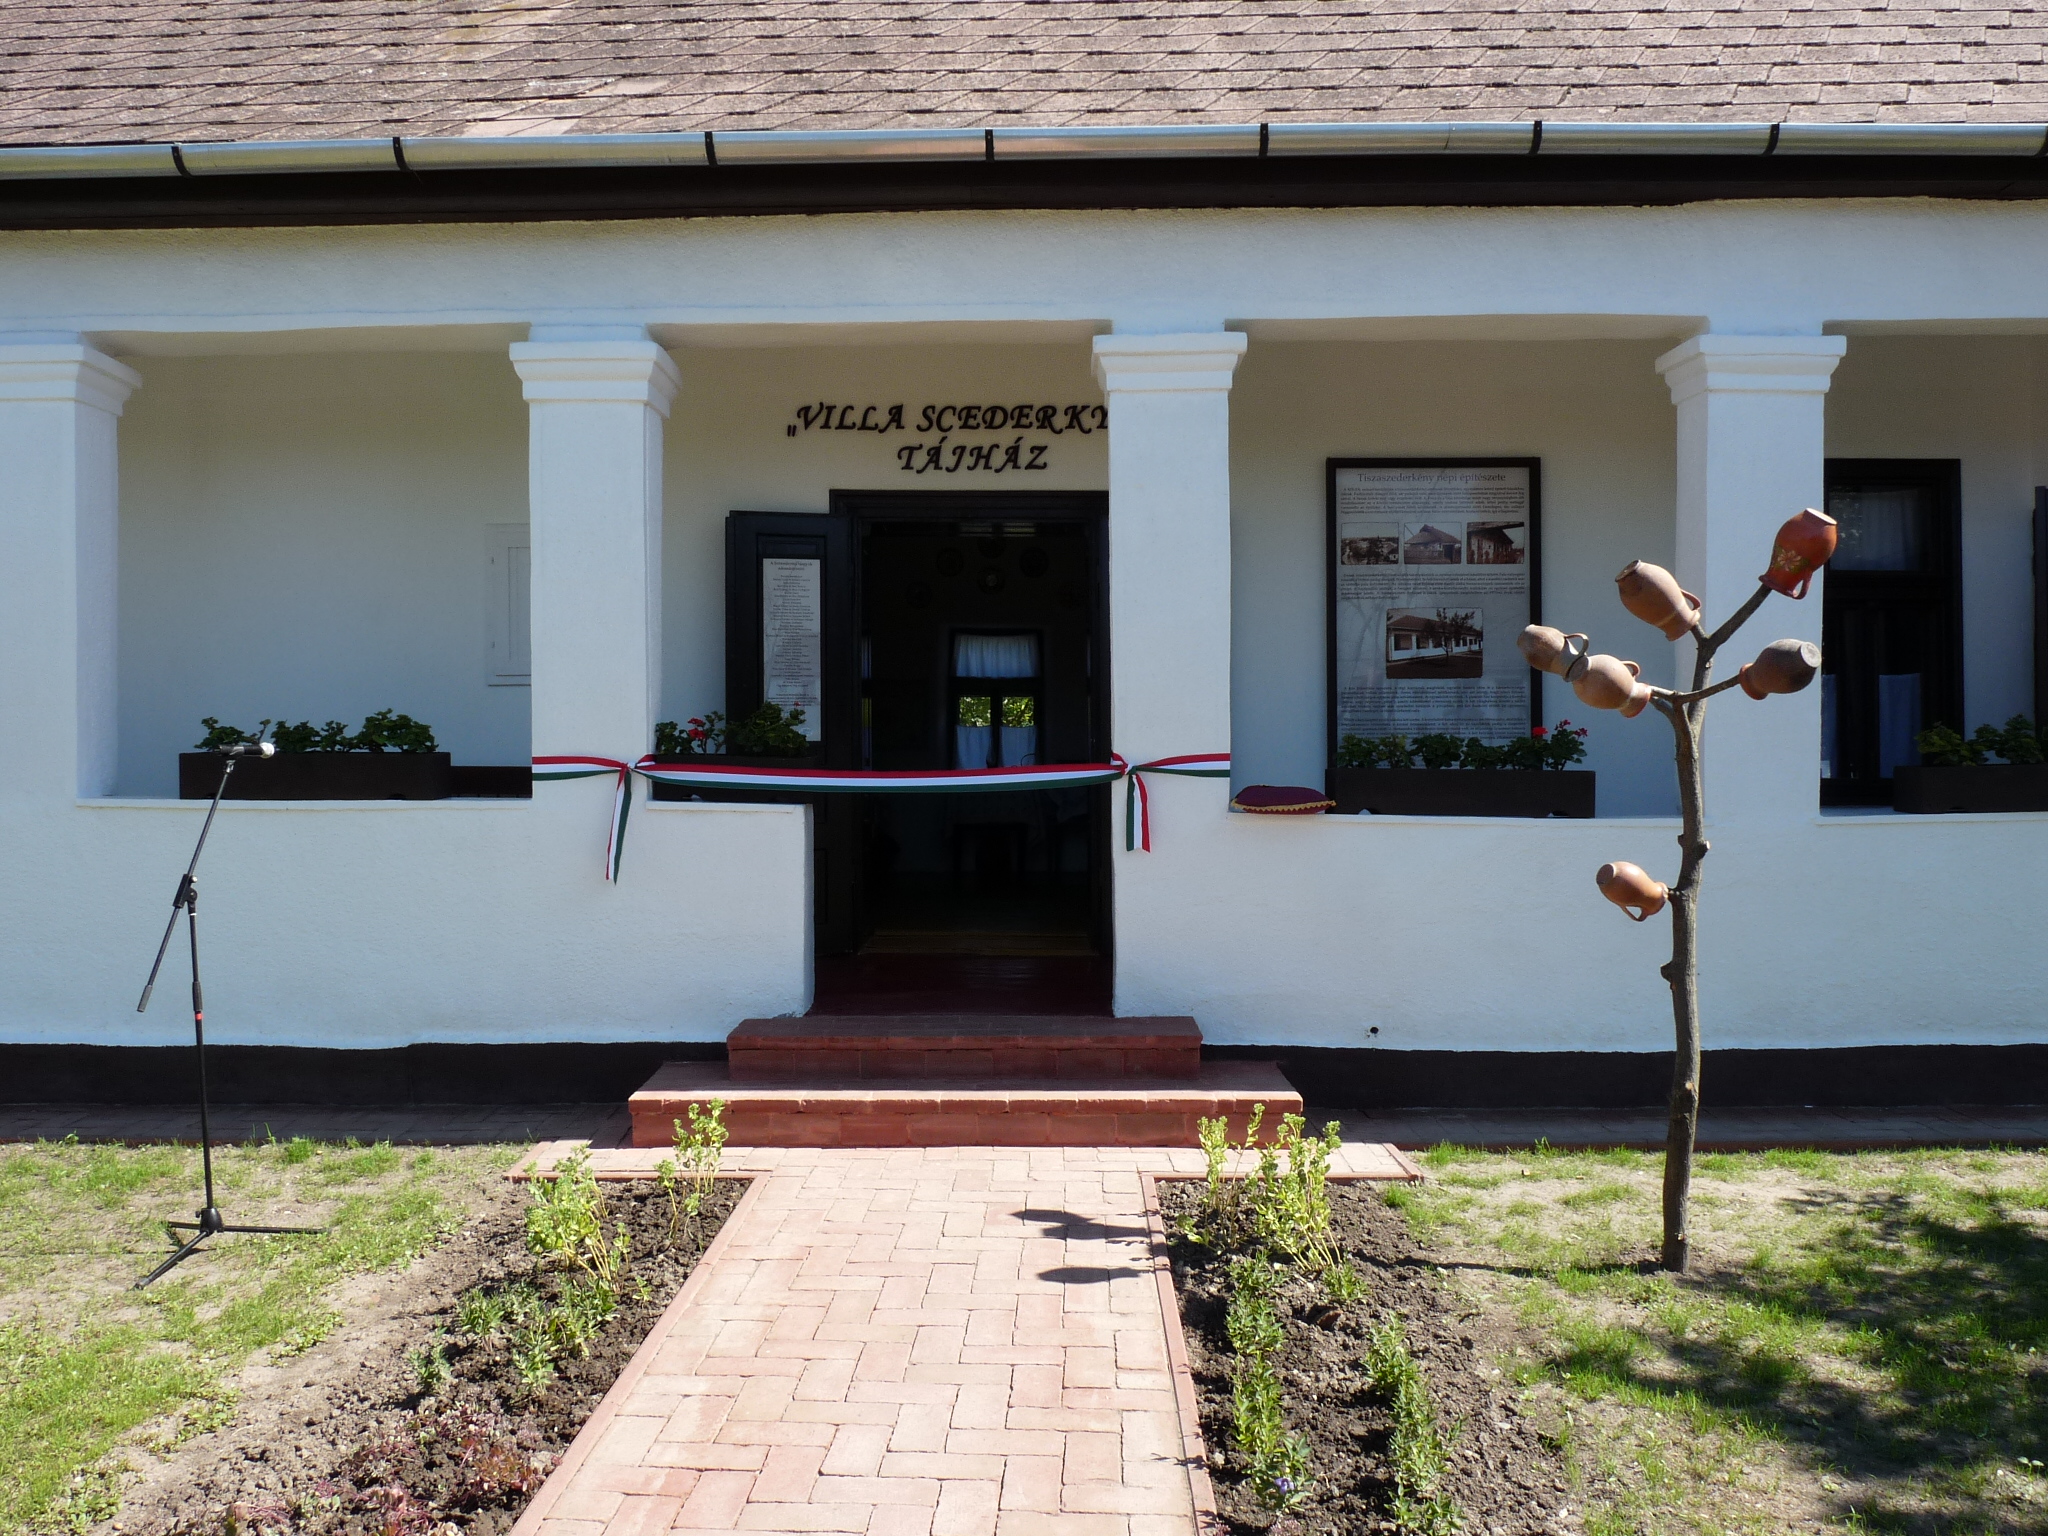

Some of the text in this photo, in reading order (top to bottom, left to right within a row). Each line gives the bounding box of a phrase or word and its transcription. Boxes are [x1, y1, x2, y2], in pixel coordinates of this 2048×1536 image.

[897, 436, 1049, 474] TÁJHÁZ
[1357, 472, 1506, 484] Tiszaszederkény népi építészete
